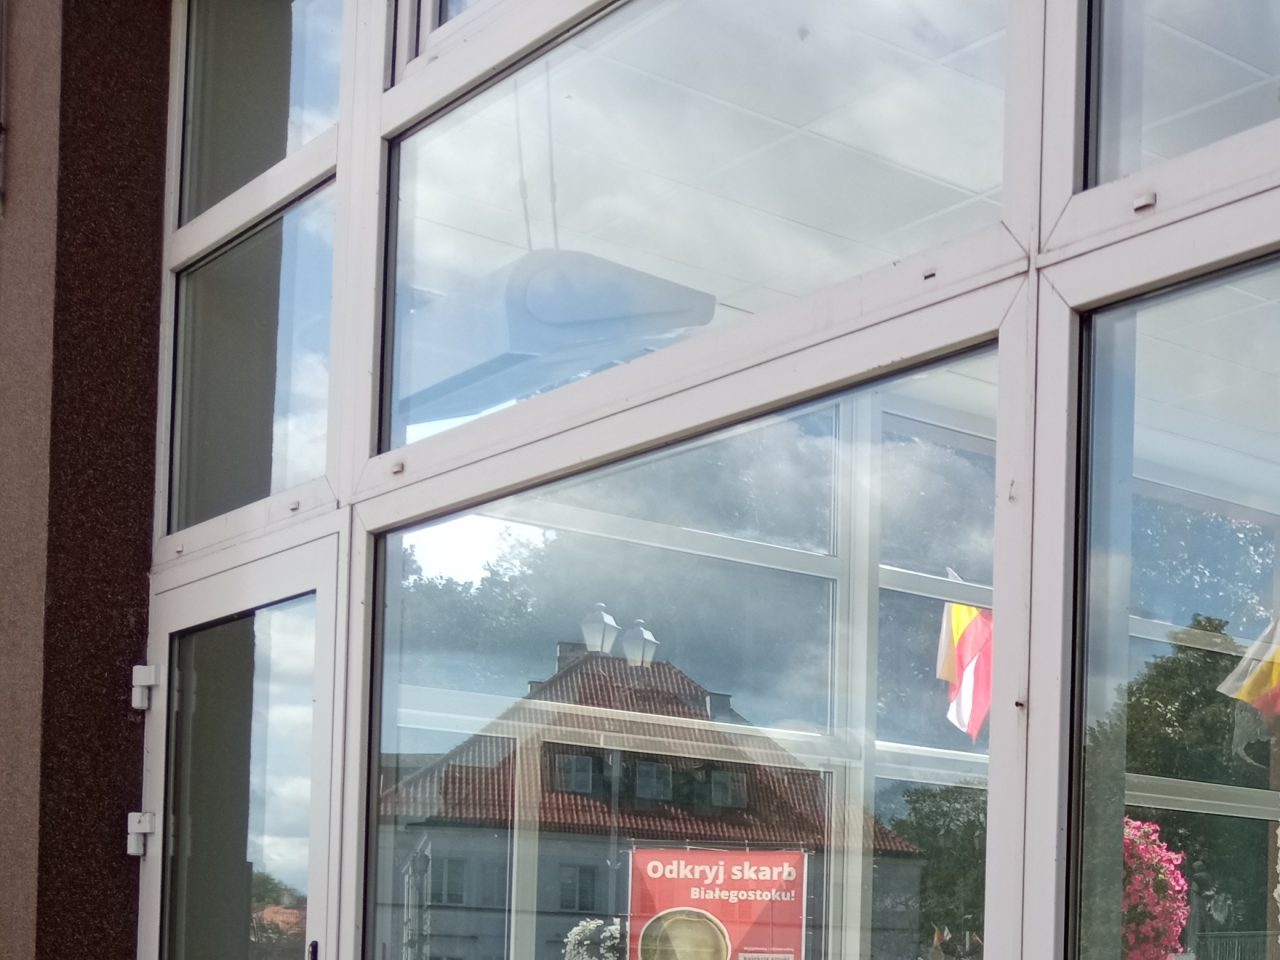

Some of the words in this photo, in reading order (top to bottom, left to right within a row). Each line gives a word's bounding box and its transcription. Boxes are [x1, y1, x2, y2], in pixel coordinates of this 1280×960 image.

[647, 860, 725, 885] Odkryj
[731, 861, 797, 881] skarb
[690, 887, 795, 903] Białegostoku!
